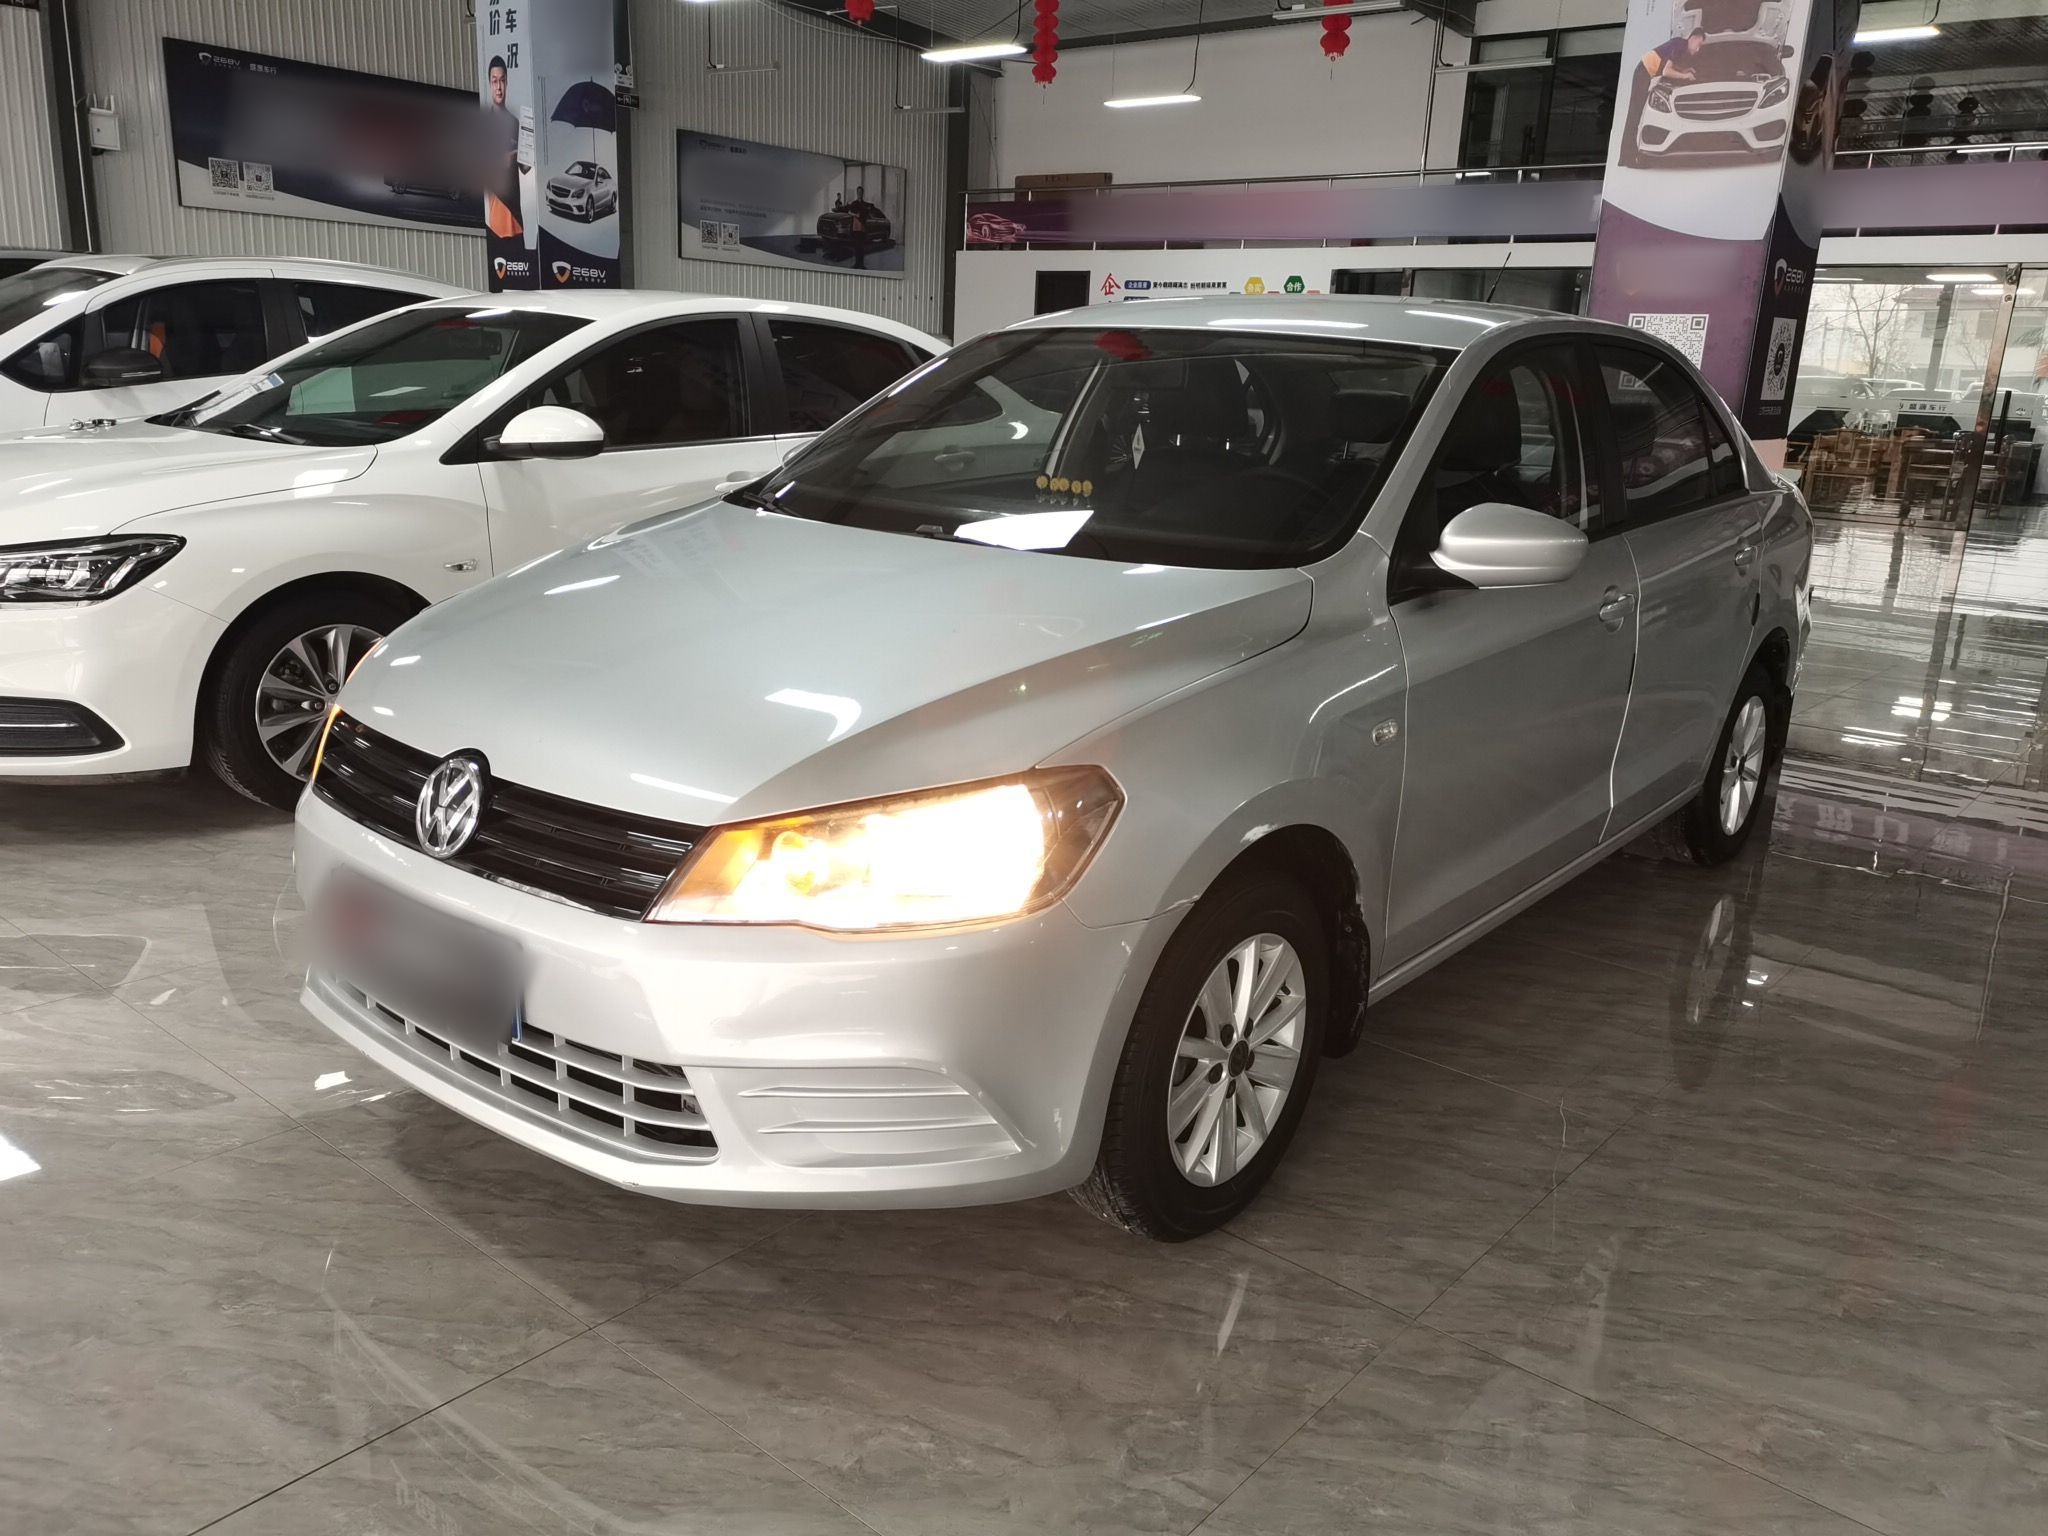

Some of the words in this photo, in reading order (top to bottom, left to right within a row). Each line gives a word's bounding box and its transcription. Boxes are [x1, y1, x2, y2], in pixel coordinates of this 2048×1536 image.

[505, 8, 519, 69] 车况
[213, 55, 240, 66] 268V
[506, 261, 529, 271] 268V
[572, 266, 606, 279] 268V
[1785, 267, 1807, 284] 268V
[1101, 272, 1122, 296] 企
[1286, 281, 1302, 292] 合作
